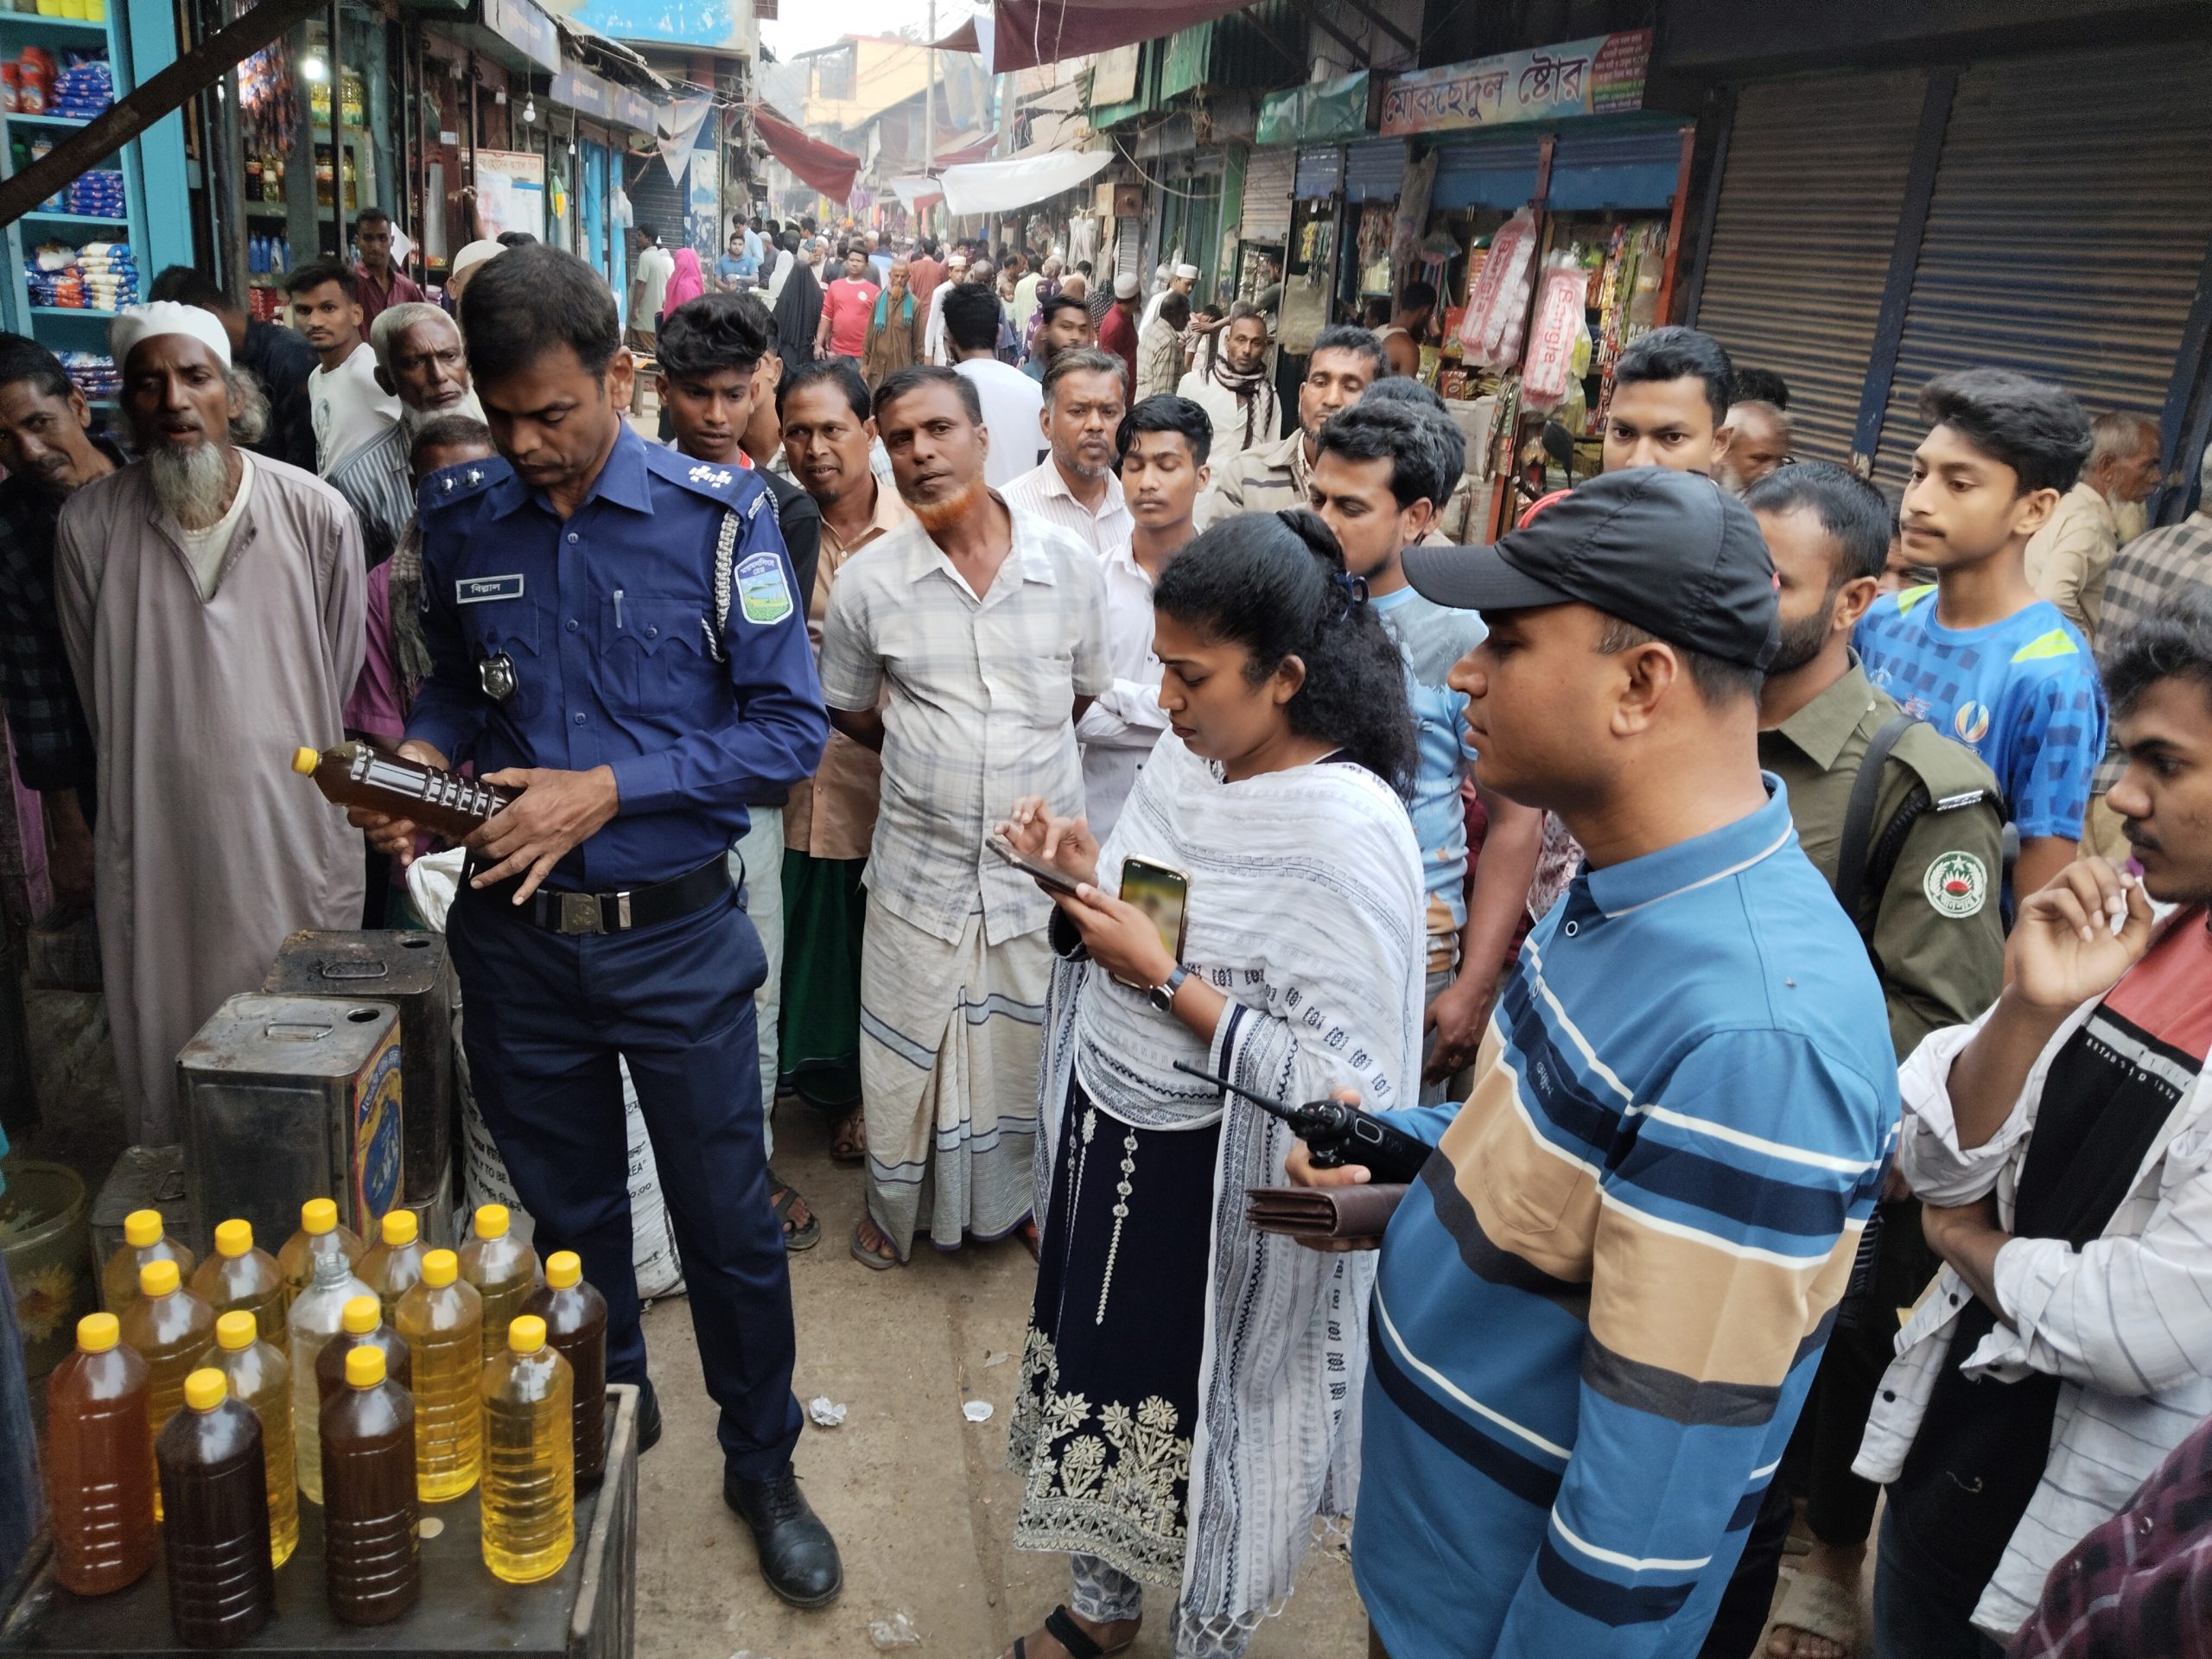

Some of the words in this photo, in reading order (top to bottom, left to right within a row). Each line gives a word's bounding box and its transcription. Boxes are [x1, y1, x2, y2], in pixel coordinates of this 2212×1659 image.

[1516, 50, 1590, 106] ষ্টোর
[484, 1161, 495, 1178] TO
[495, 1167, 508, 1184] BE
